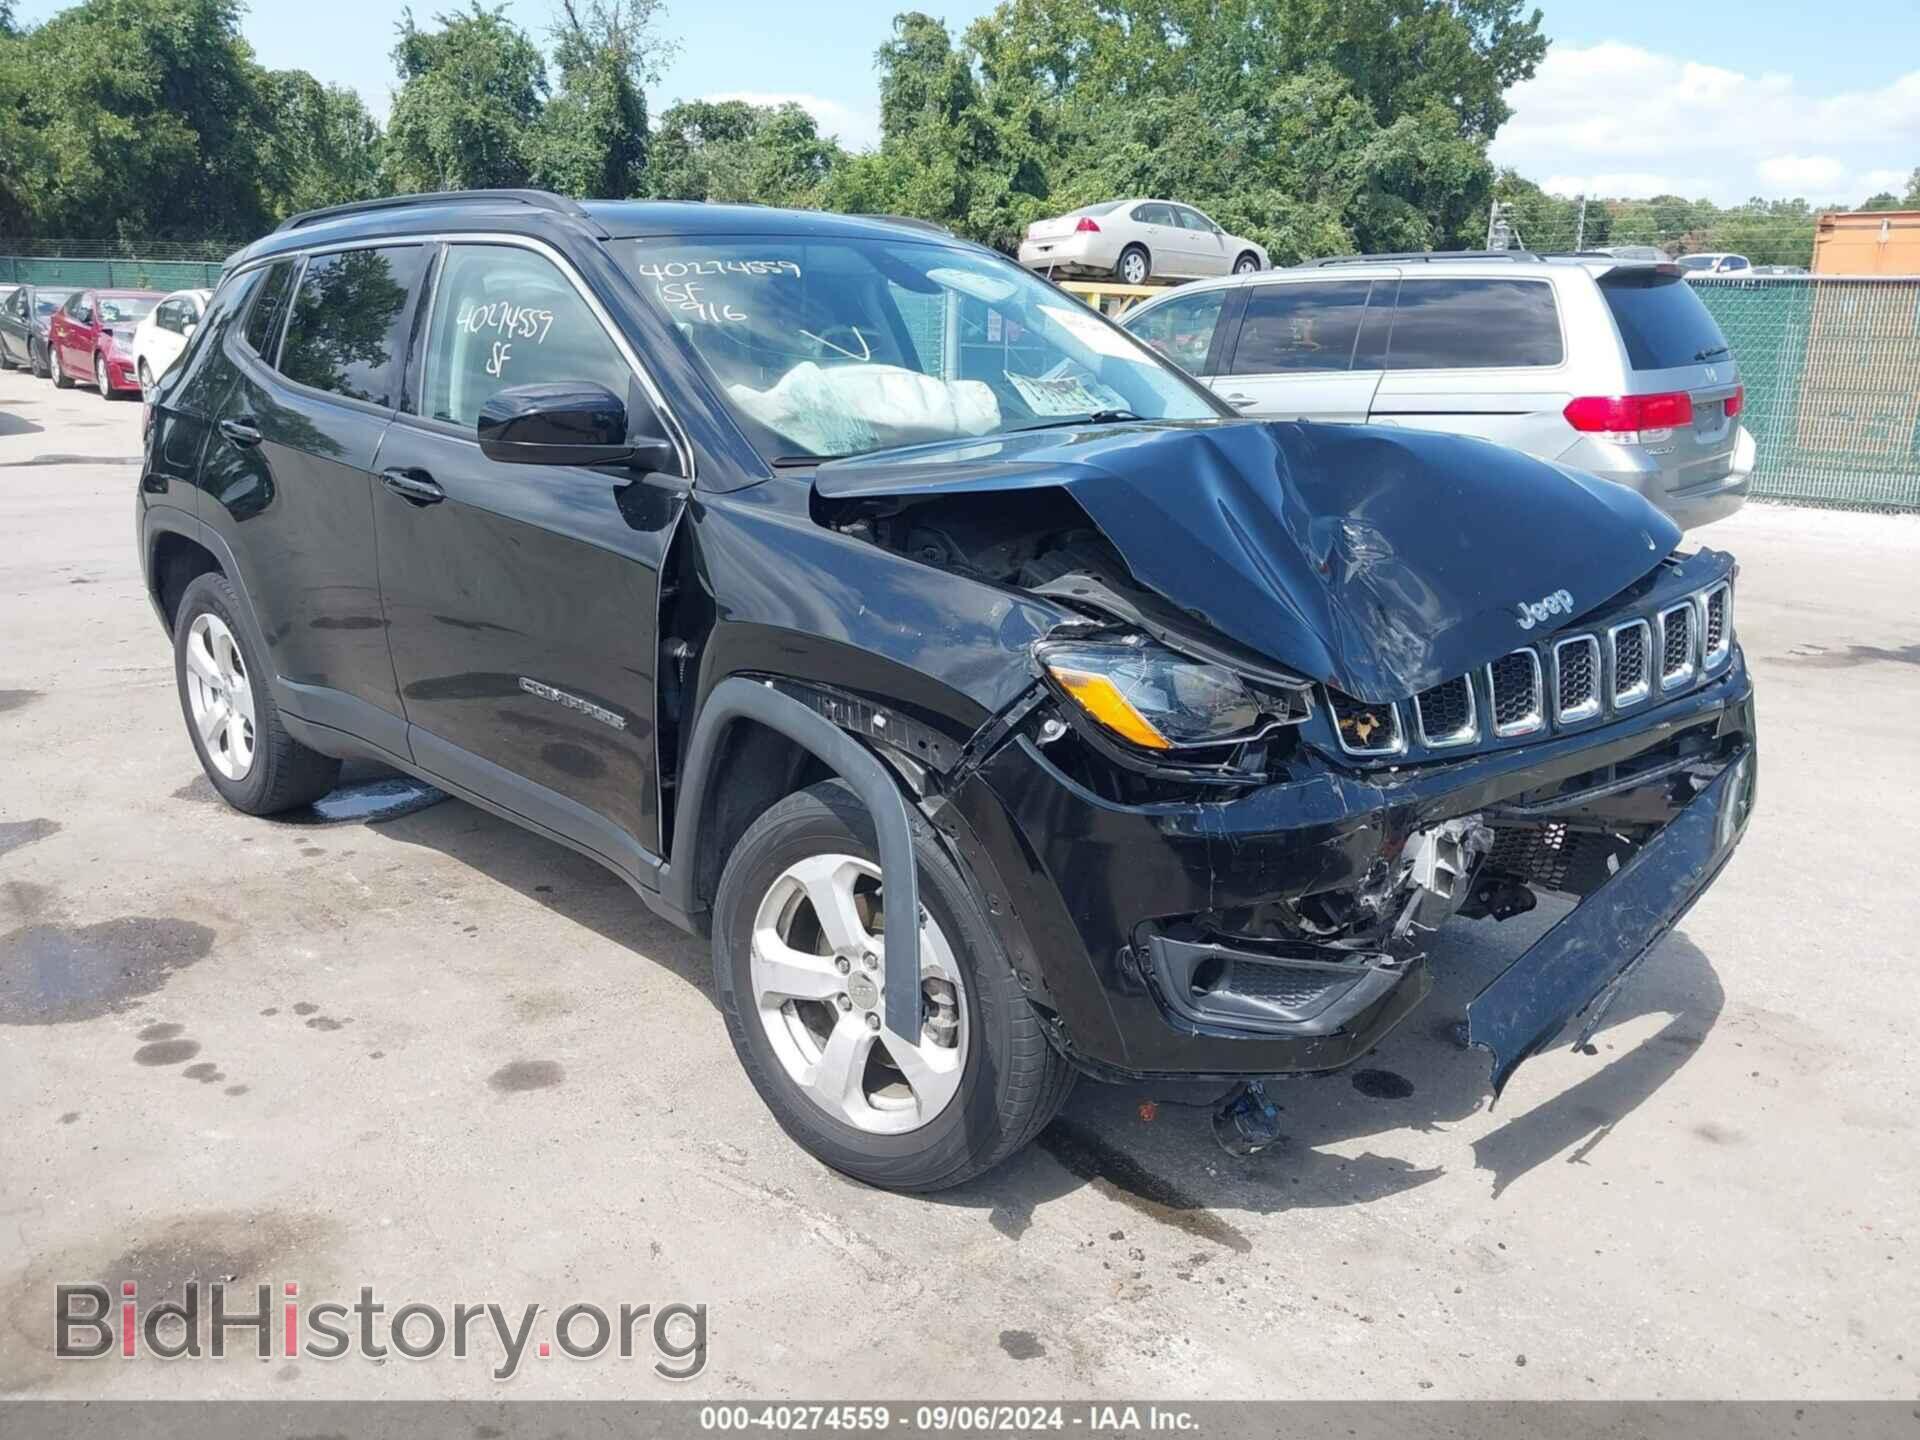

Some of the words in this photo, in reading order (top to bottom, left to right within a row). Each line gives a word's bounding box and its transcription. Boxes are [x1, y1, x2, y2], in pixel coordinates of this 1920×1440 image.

[639, 260, 801, 281] 40274559
[663, 282, 704, 302] SF
[680, 302, 748, 323] 916
[1517, 588, 1574, 630] Jeep
